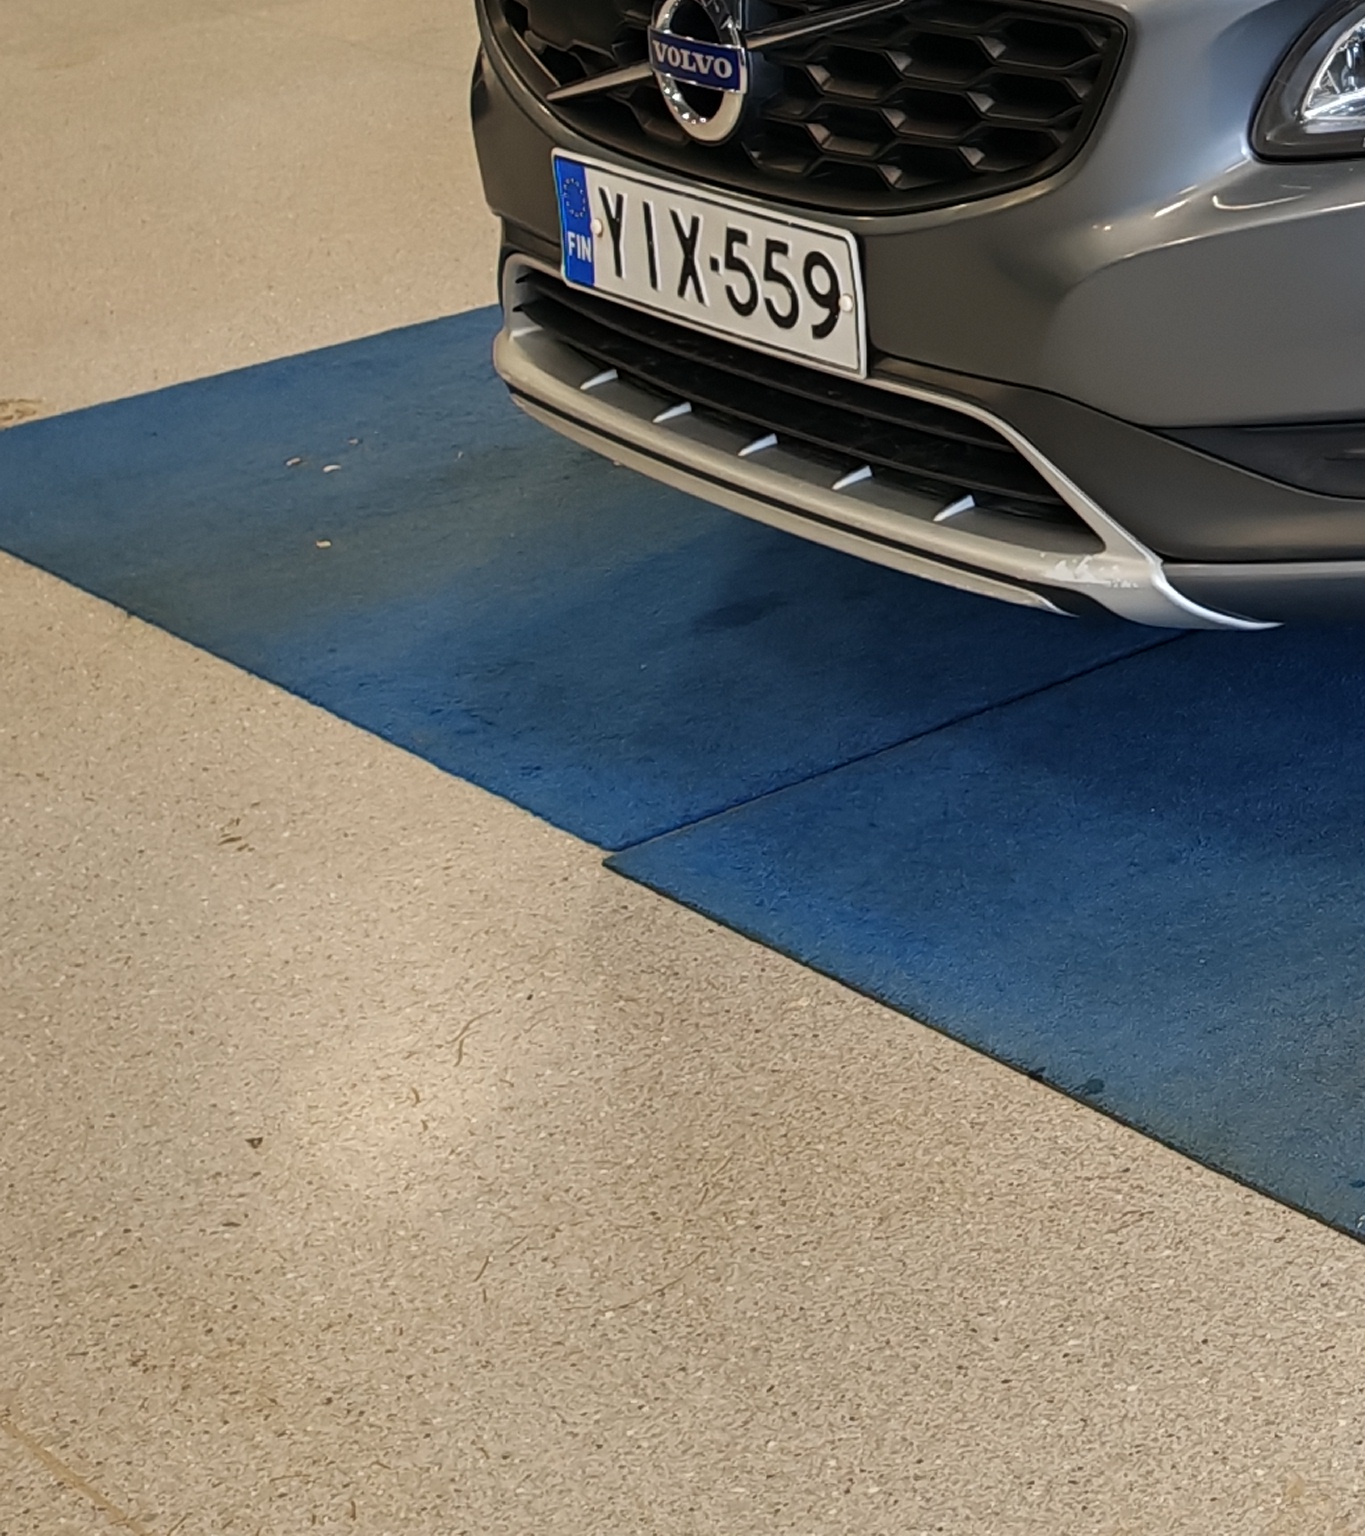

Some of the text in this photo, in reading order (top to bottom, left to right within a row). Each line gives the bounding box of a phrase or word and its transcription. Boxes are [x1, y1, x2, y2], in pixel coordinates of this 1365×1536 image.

[652, 39, 733, 80] VOLVO
[567, 186, 840, 340] FIN YIX-559
